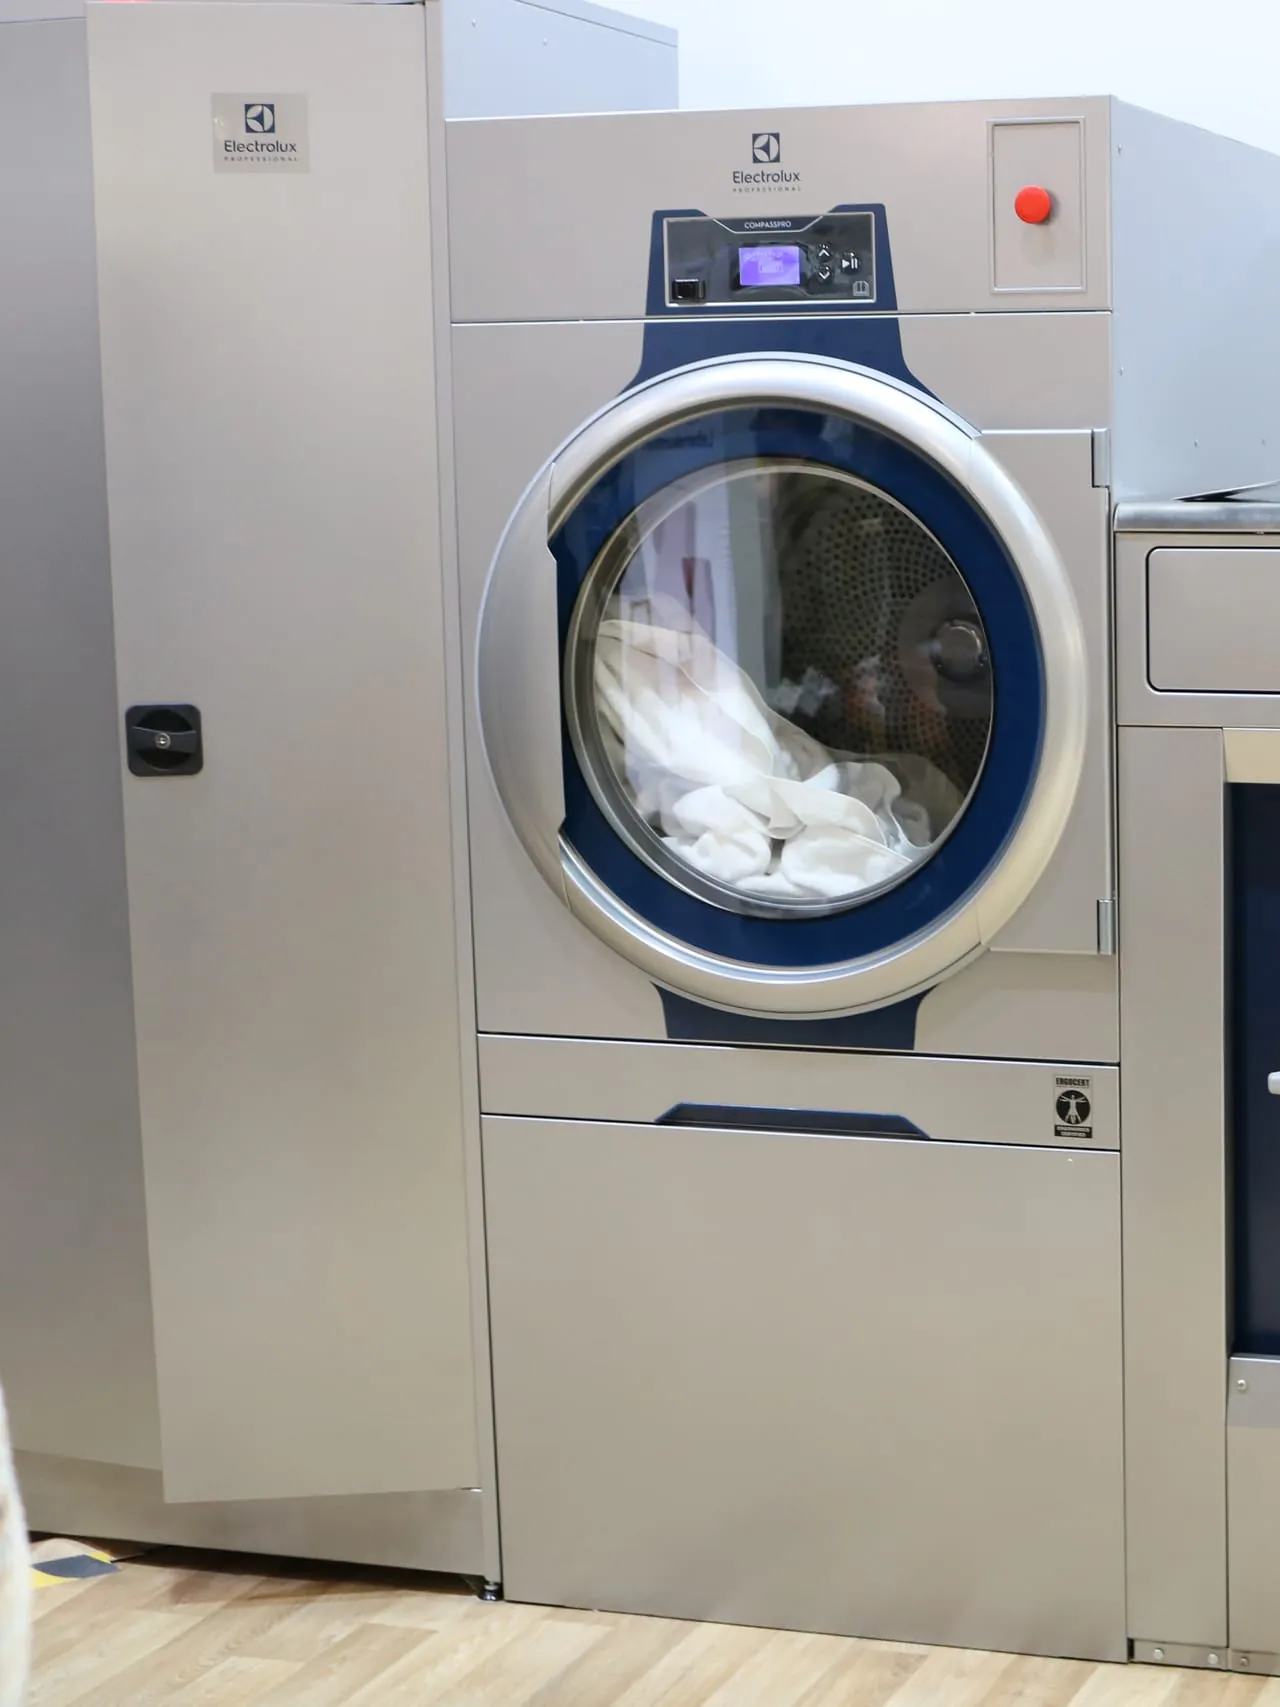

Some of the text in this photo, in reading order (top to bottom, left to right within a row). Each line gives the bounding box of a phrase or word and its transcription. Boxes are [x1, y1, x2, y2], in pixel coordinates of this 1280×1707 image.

[224, 140, 297, 153] Electrolux
[732, 169, 801, 184] Electrolux
[744, 220, 792, 229] COMPASSPRO
